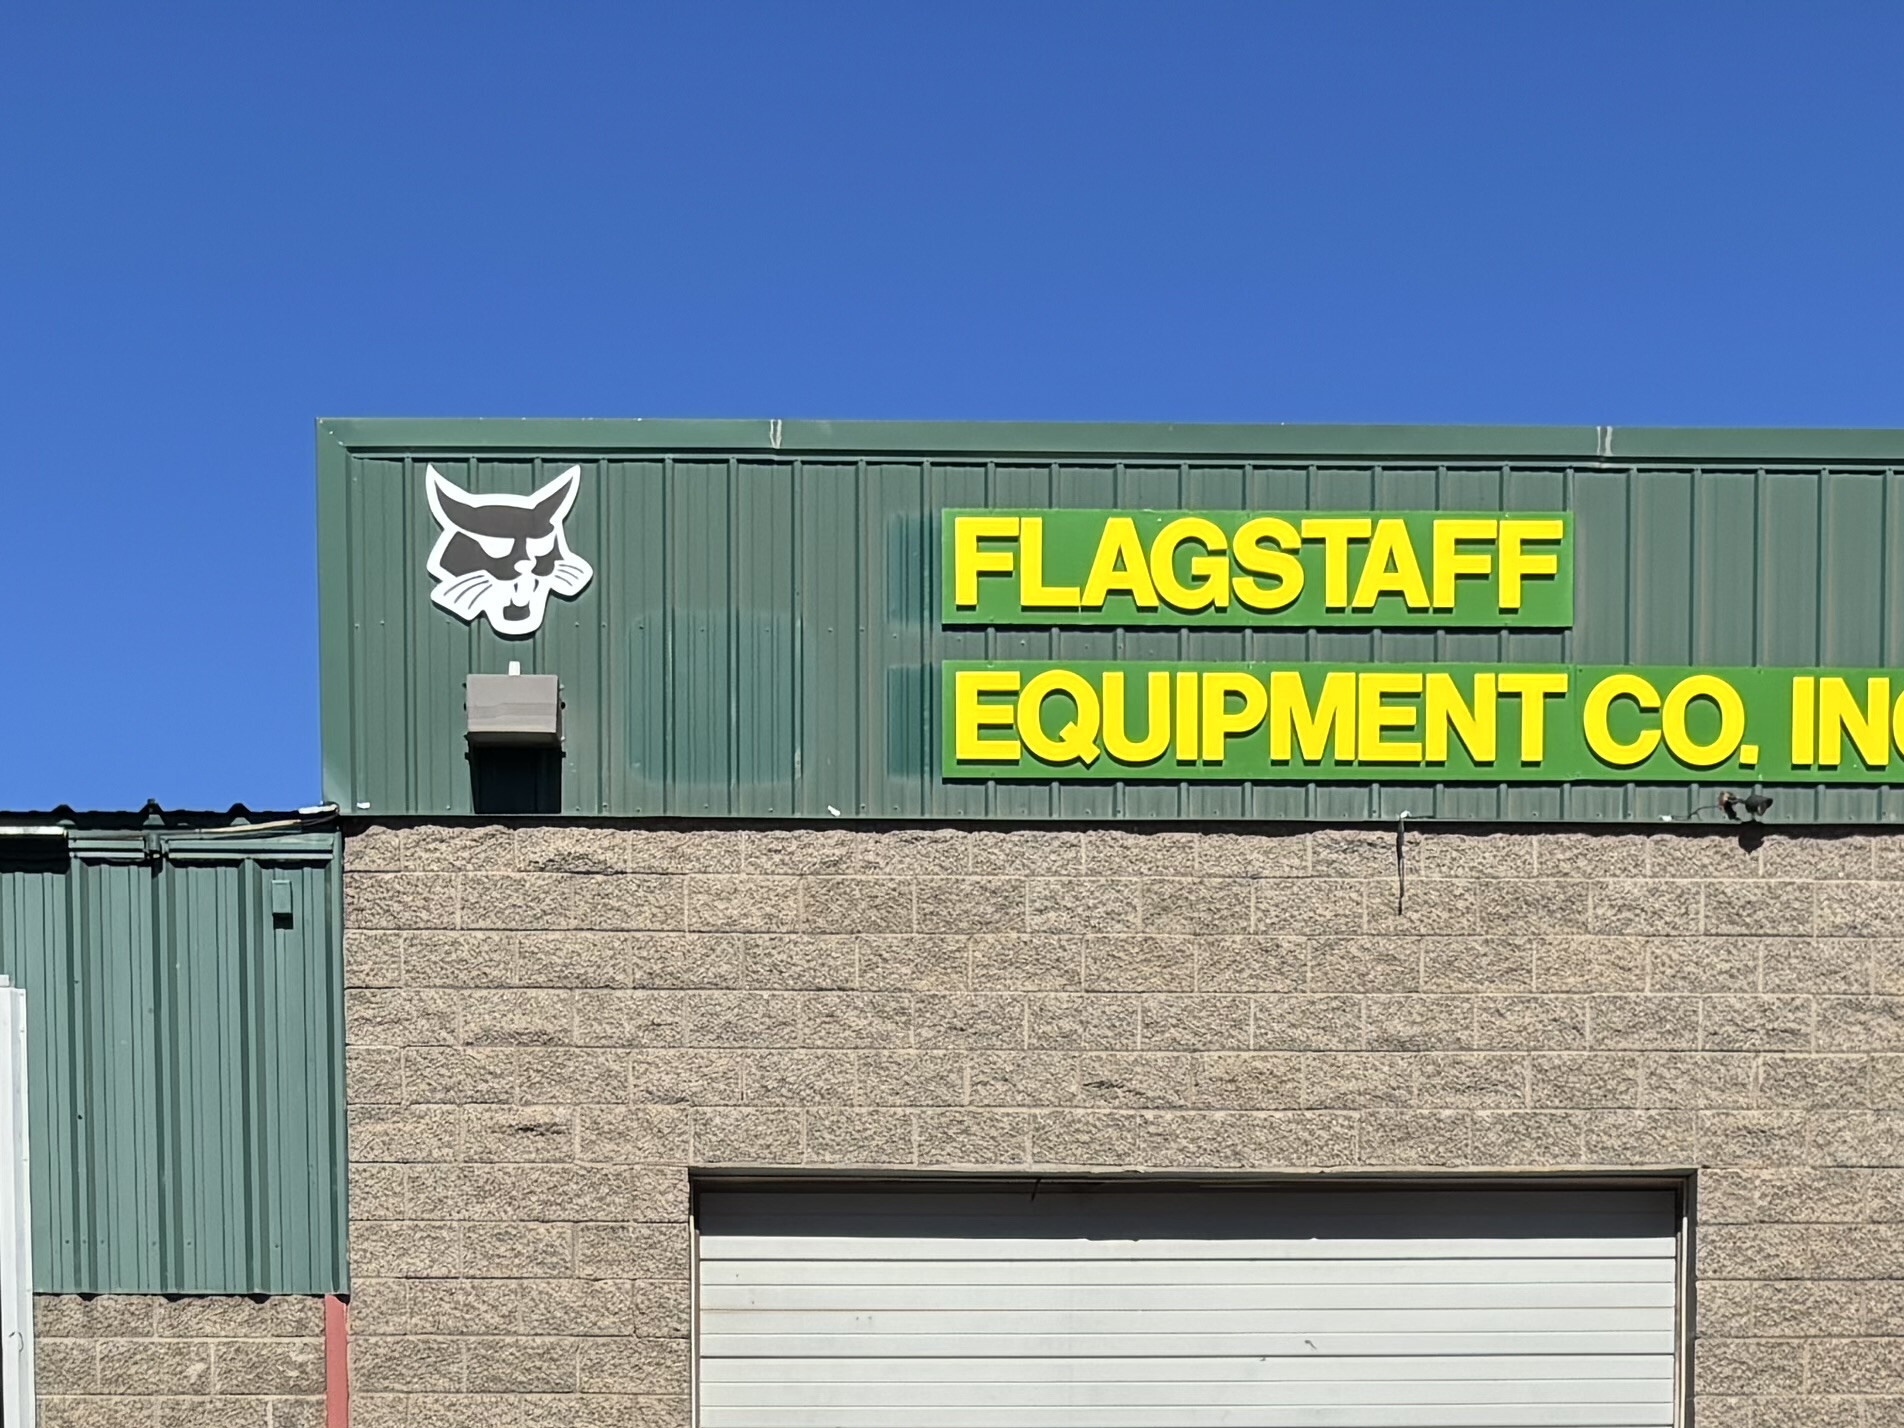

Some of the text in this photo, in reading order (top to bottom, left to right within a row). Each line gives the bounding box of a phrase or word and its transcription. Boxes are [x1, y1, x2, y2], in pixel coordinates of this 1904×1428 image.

[955, 517, 1565, 609] FLAGSTAFF
[955, 669, 1569, 764] EQUIPMENT
[1583, 673, 1760, 767] CO.
